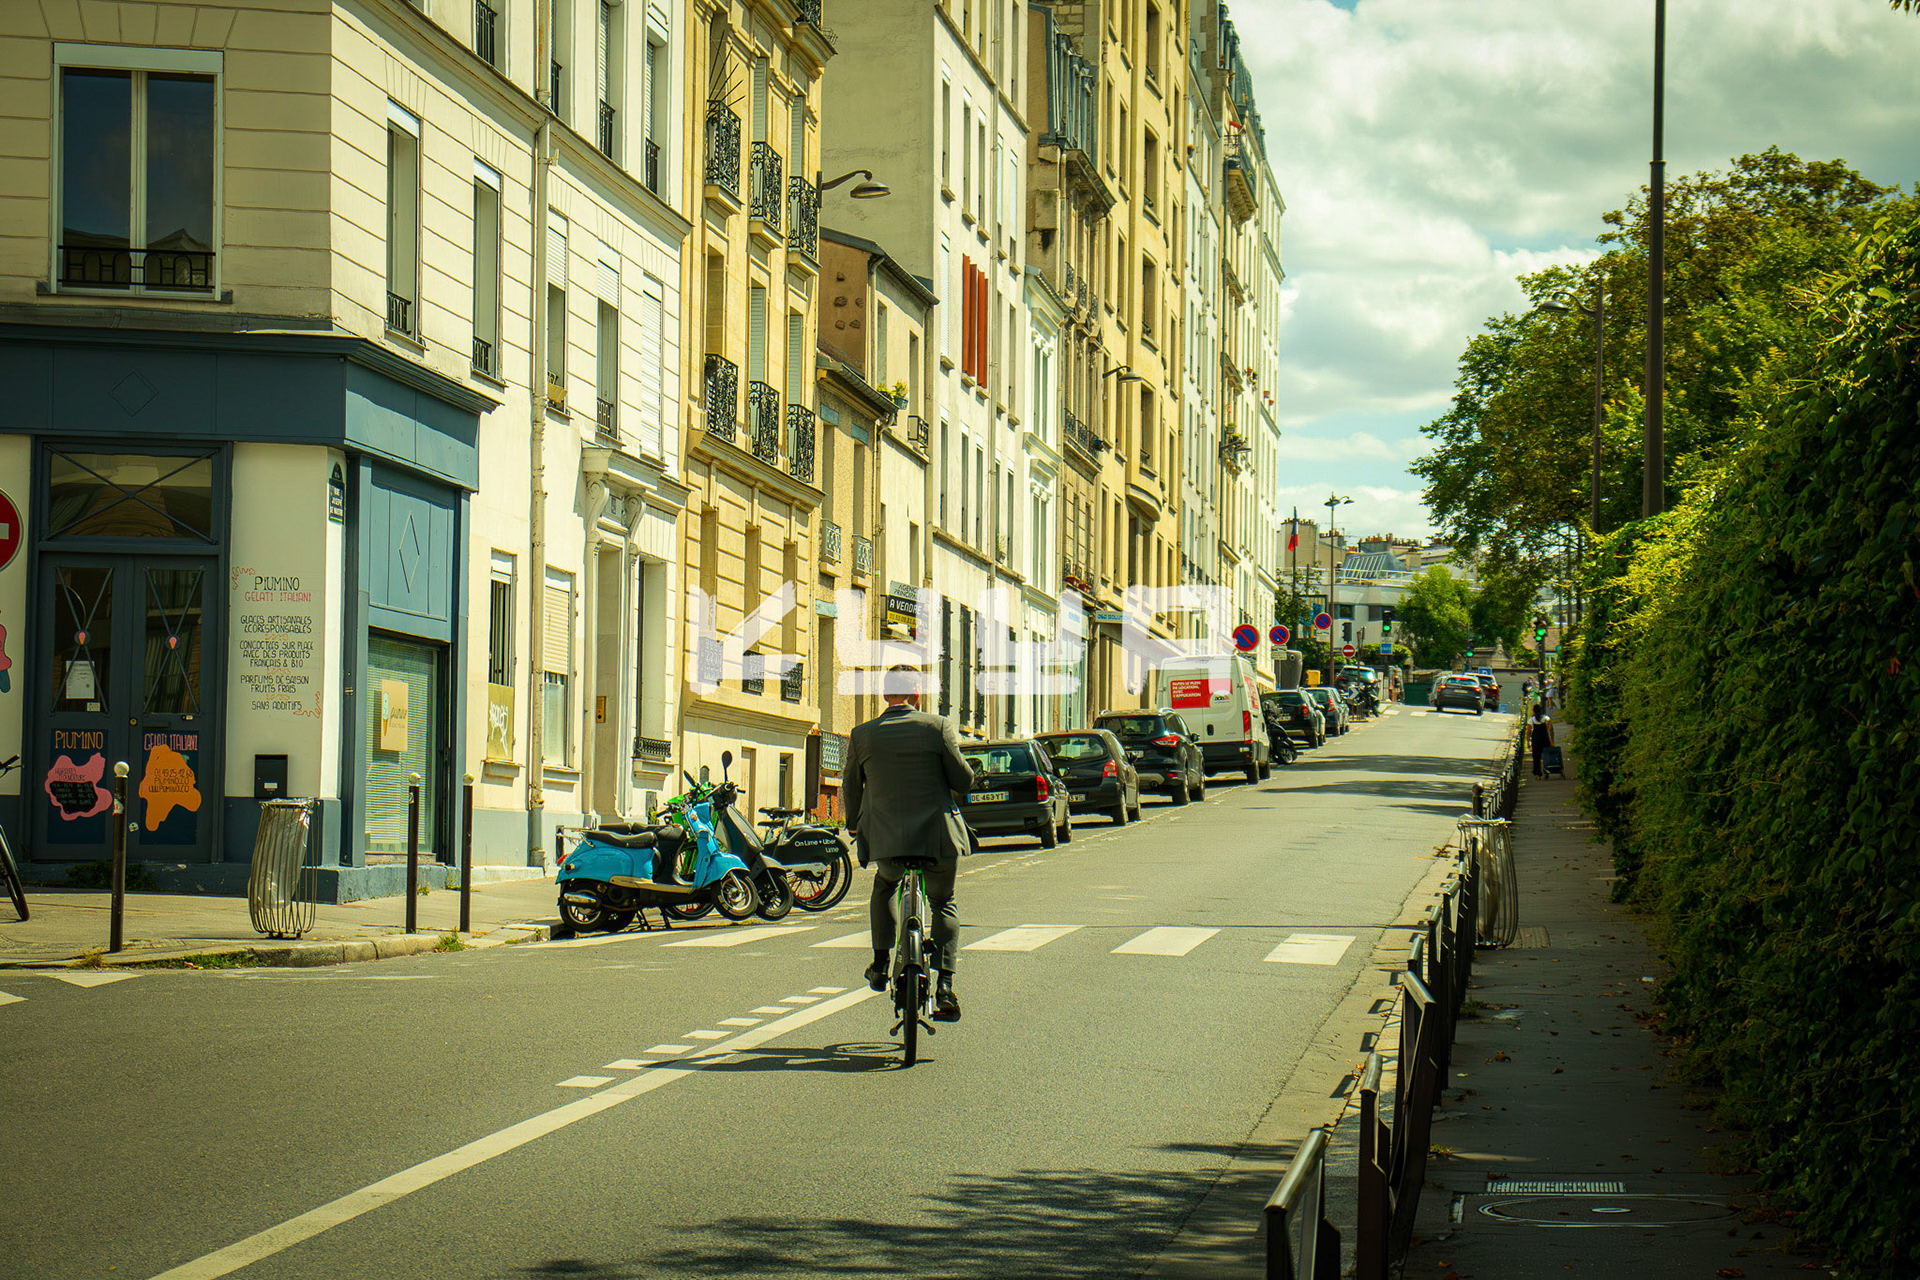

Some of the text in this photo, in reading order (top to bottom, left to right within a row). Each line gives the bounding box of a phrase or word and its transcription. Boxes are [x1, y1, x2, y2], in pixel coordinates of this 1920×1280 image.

[244, 591, 312, 602] GELATI ITALIANI
[896, 599, 923, 616] VENDRE
[240, 614, 312, 625] GLACES ARTISANALES
[281, 641, 296, 650] SUR
[297, 641, 314, 651] PLACE
[242, 649, 311, 659] AVEC DES PRODUITS
[282, 659, 288, 668] &
[290, 659, 304, 668] BIO
[240, 674, 310, 685] PARFUMS DE SAISON
[250, 684, 297, 693] FRUITS FRAIS
[251, 700, 303, 711] SANS ADDITIFS
[55, 730, 104, 749] PIUMINO
[169, 734, 198, 751] ITALIANI
